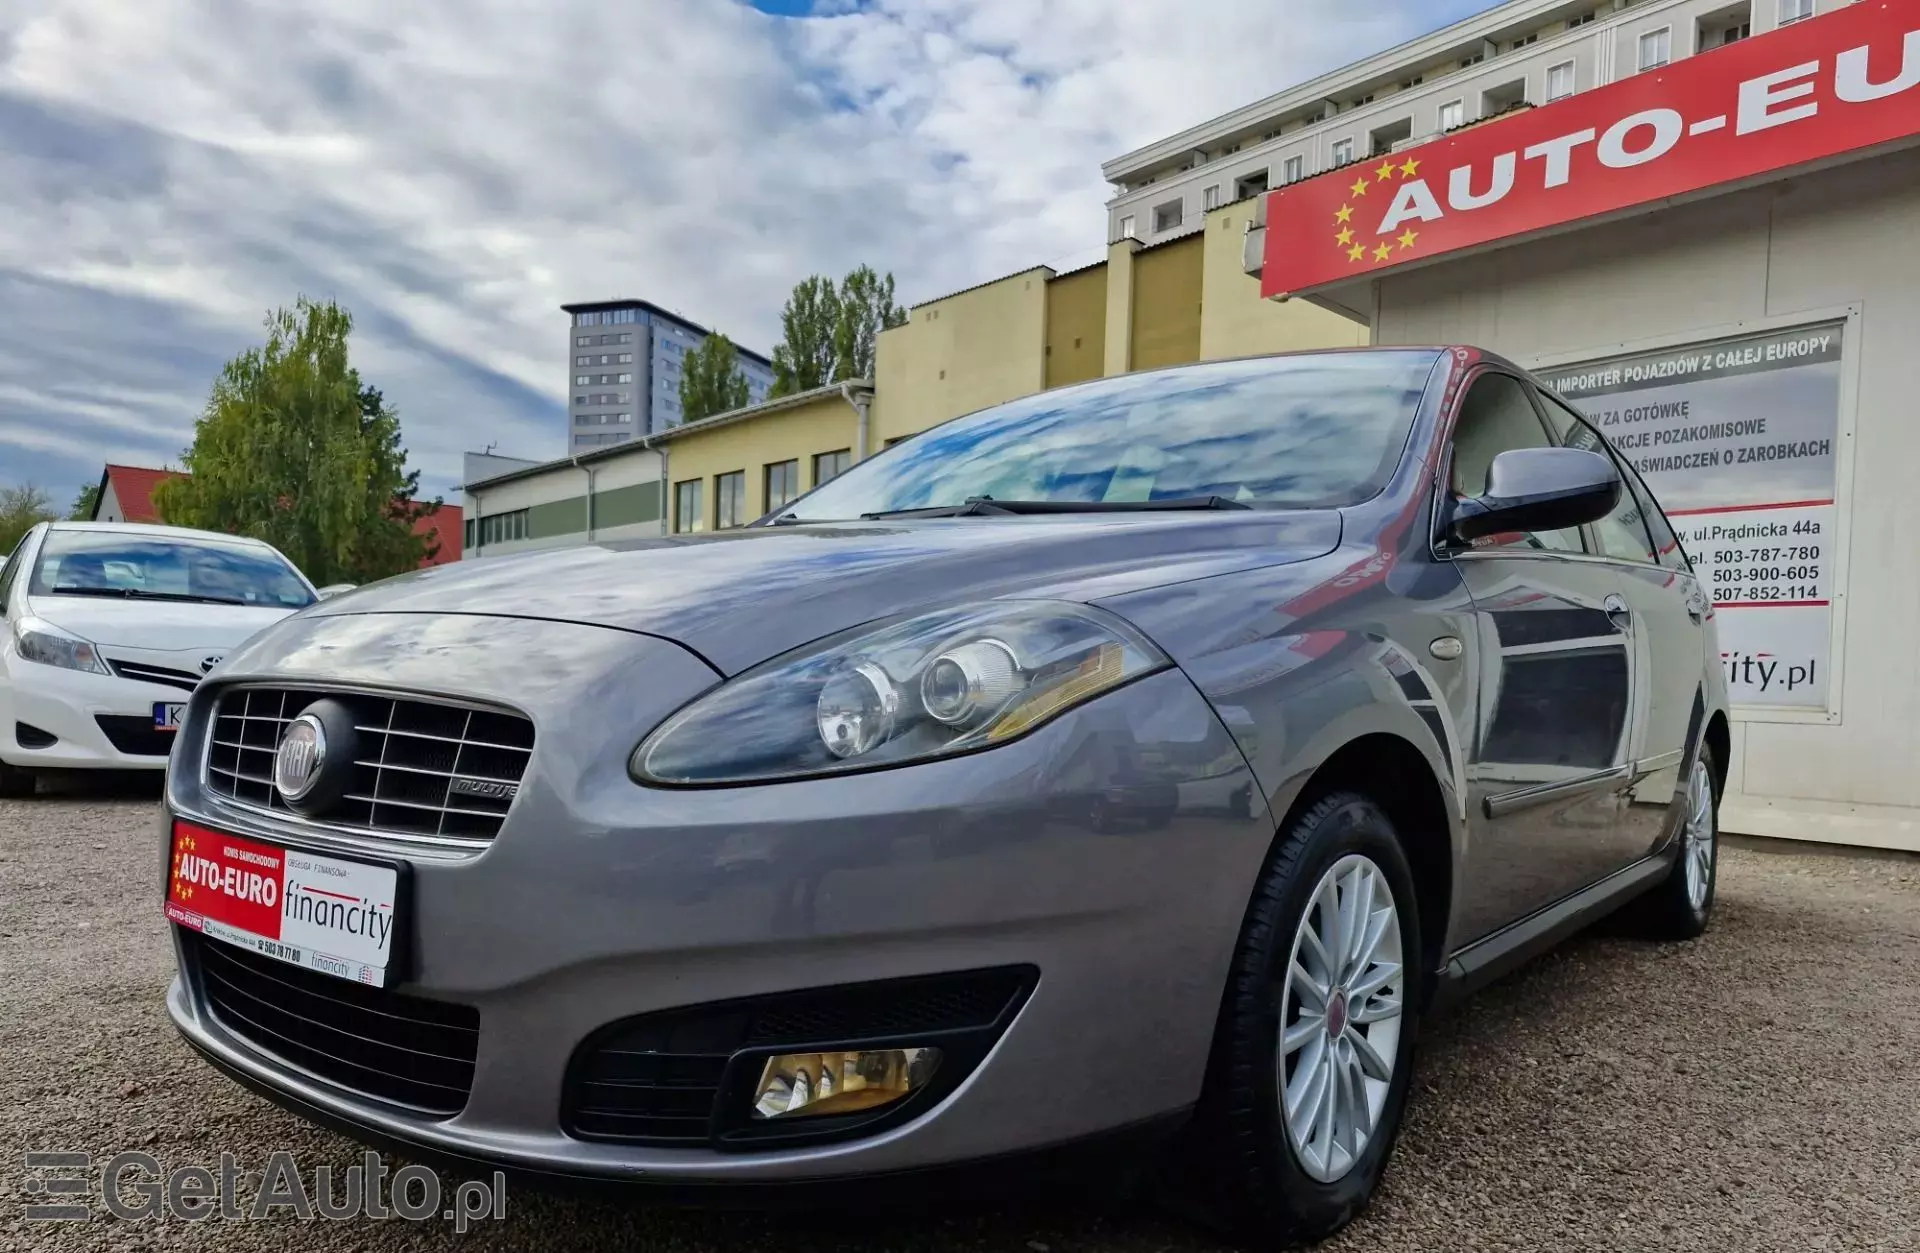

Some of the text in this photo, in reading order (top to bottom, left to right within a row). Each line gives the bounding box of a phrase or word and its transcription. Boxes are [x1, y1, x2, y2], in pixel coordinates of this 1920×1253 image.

[1376, 29, 1920, 235] AUTO-EU
[1557, 335, 1830, 394] IMPORTER POJAZDÓW Z CAŁEJ EUROPY
[1603, 410, 1620, 426] ZA
[1624, 401, 1689, 423] GOTÓWKĘ
[1654, 418, 1766, 446] POZAKOMISOWE
[1630, 439, 1830, 473] AŚWIADCZEŃ O ZAROBKACH
[1793, 520, 1821, 535] 44a
[1714, 546, 1820, 564] 503-787-780
[1713, 566, 1819, 583] 503-900-605
[1713, 585, 1818, 601] 507-852-114
[1722, 652, 1815, 692] ity.pl
[284, 740, 313, 777] FIAT
[223, 846, 280, 870] KOMIS SAMOCHODOWY
[179, 853, 277, 907] AUTO-EURO
[168, 907, 202, 928] AUTO-EURO
[285, 880, 392, 949] financity
[264, 940, 276, 956] 503
[277, 944, 284, 958] 78
[285, 946, 292, 960] 77
[311, 951, 350, 977] financity
